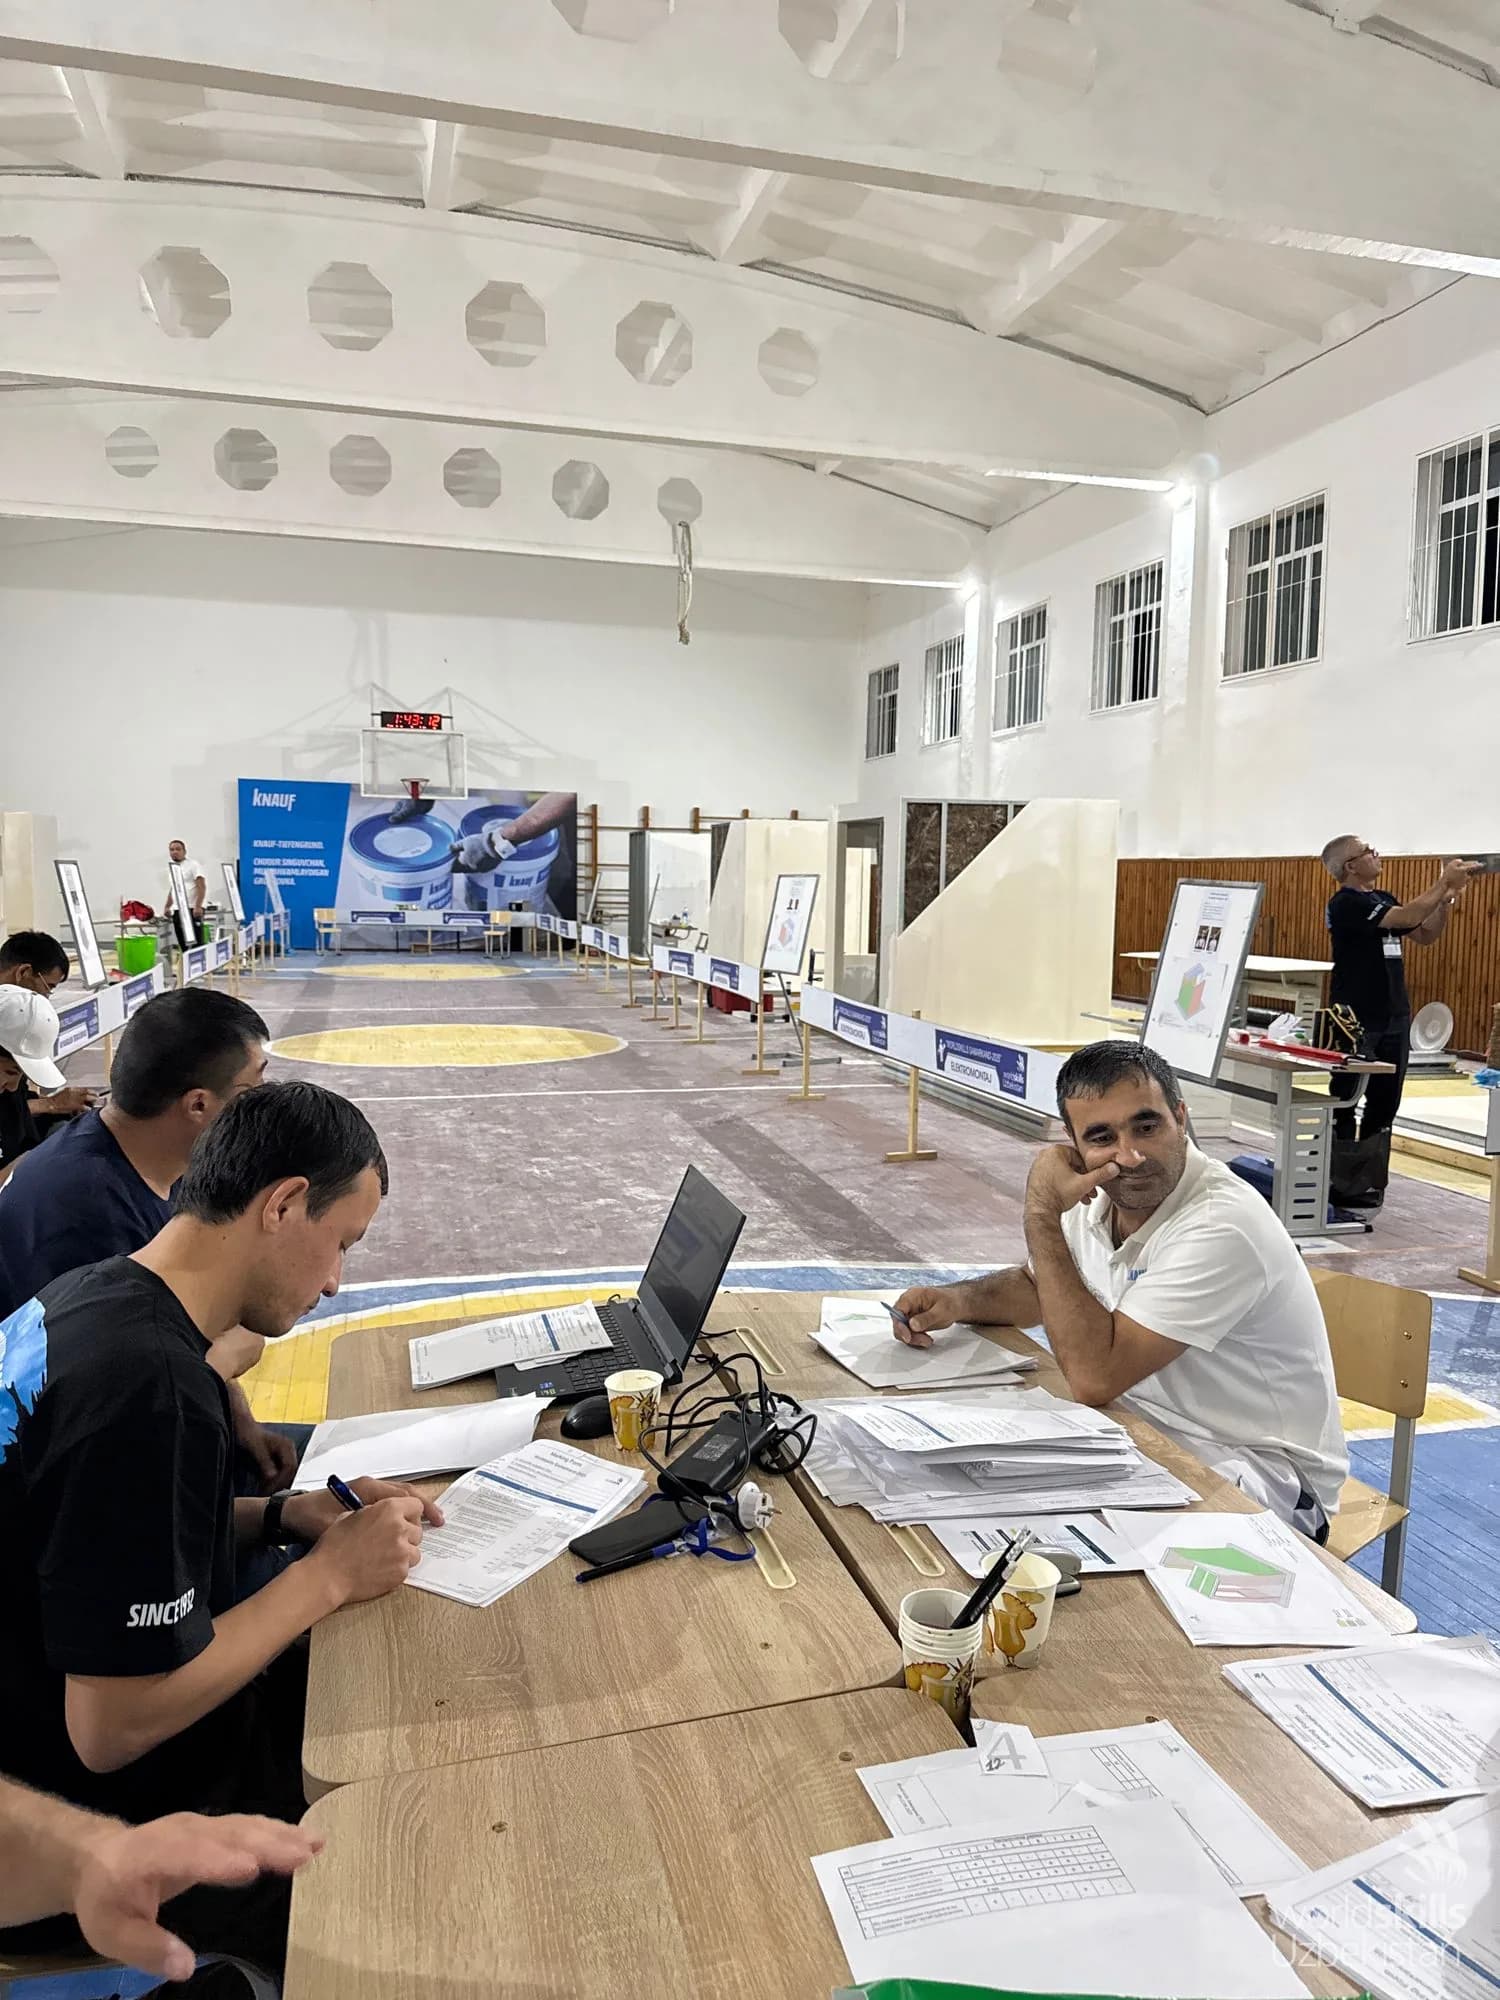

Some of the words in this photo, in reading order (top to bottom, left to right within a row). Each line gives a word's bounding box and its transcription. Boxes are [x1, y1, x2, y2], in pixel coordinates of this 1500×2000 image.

[394, 713, 441, 727] 1:43:12
[252, 787, 297, 812] KNAUF
[126, 1598, 180, 1628] SINCE
